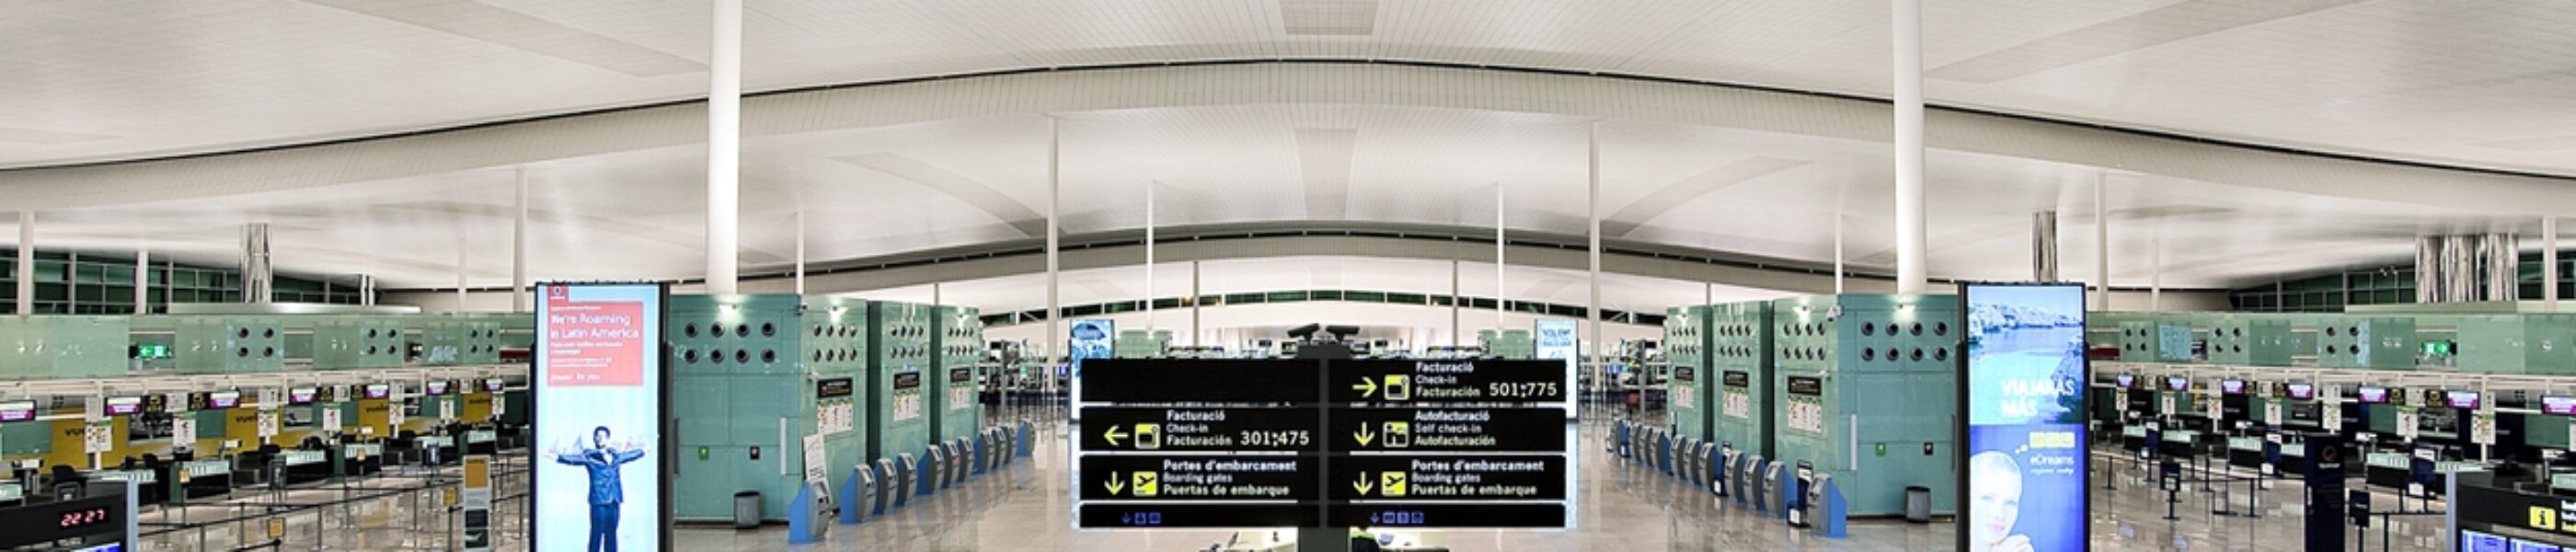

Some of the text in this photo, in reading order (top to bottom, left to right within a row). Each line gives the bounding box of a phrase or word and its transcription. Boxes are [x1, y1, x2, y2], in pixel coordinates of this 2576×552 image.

[580, 313, 632, 328] Roaming
[562, 328, 589, 339] Latin
[591, 328, 640, 339] America
[1415, 362, 1475, 373] Facturació
[1415, 374, 1457, 385] Check-in
[1415, 385, 1481, 397] Facturación
[1166, 409, 1225, 421] Facturació
[1414, 409, 1490, 421] Autofacturació
[1166, 422, 1209, 433] Check-in
[1414, 422, 1482, 433] Self check-in
[1166, 434, 1233, 446] Facturación
[1414, 435, 1496, 446] Autofacturación
[1163, 459, 1297, 471] Portes d'embarcament
[1411, 459, 1545, 471] Portes d'embarcament
[1163, 472, 1233, 484] Boarding gates
[1411, 472, 1481, 484] Boarding gates
[1163, 484, 1290, 497] Puertas de embarque
[1411, 484, 1537, 497] Puertas de embarque
